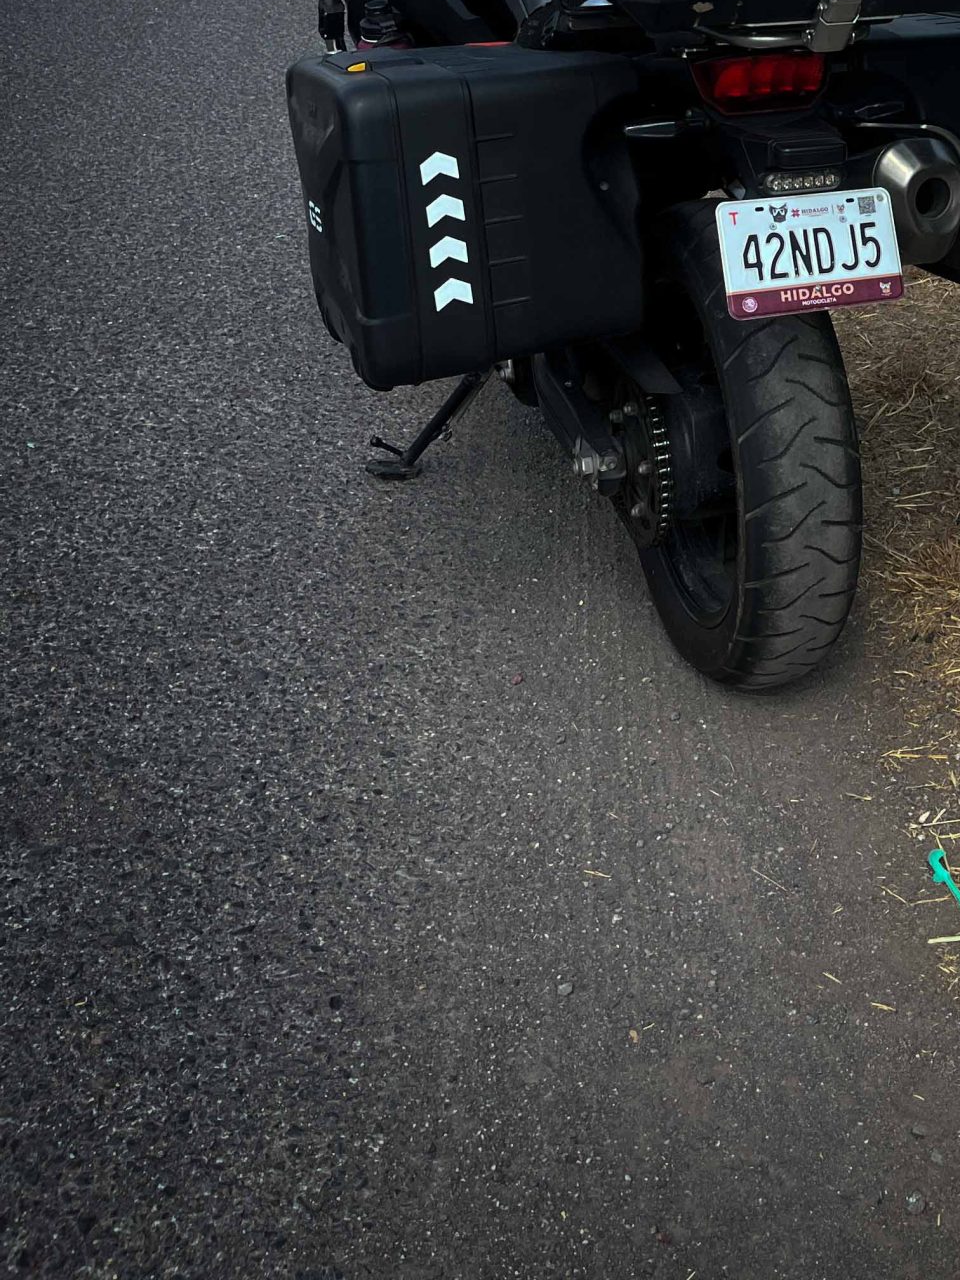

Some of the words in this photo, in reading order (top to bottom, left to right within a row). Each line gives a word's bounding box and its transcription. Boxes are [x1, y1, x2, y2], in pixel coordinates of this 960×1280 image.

[728, 211, 739, 226] T
[743, 222, 882, 281] 42NDJ5
[780, 283, 855, 302] HIDALGO
